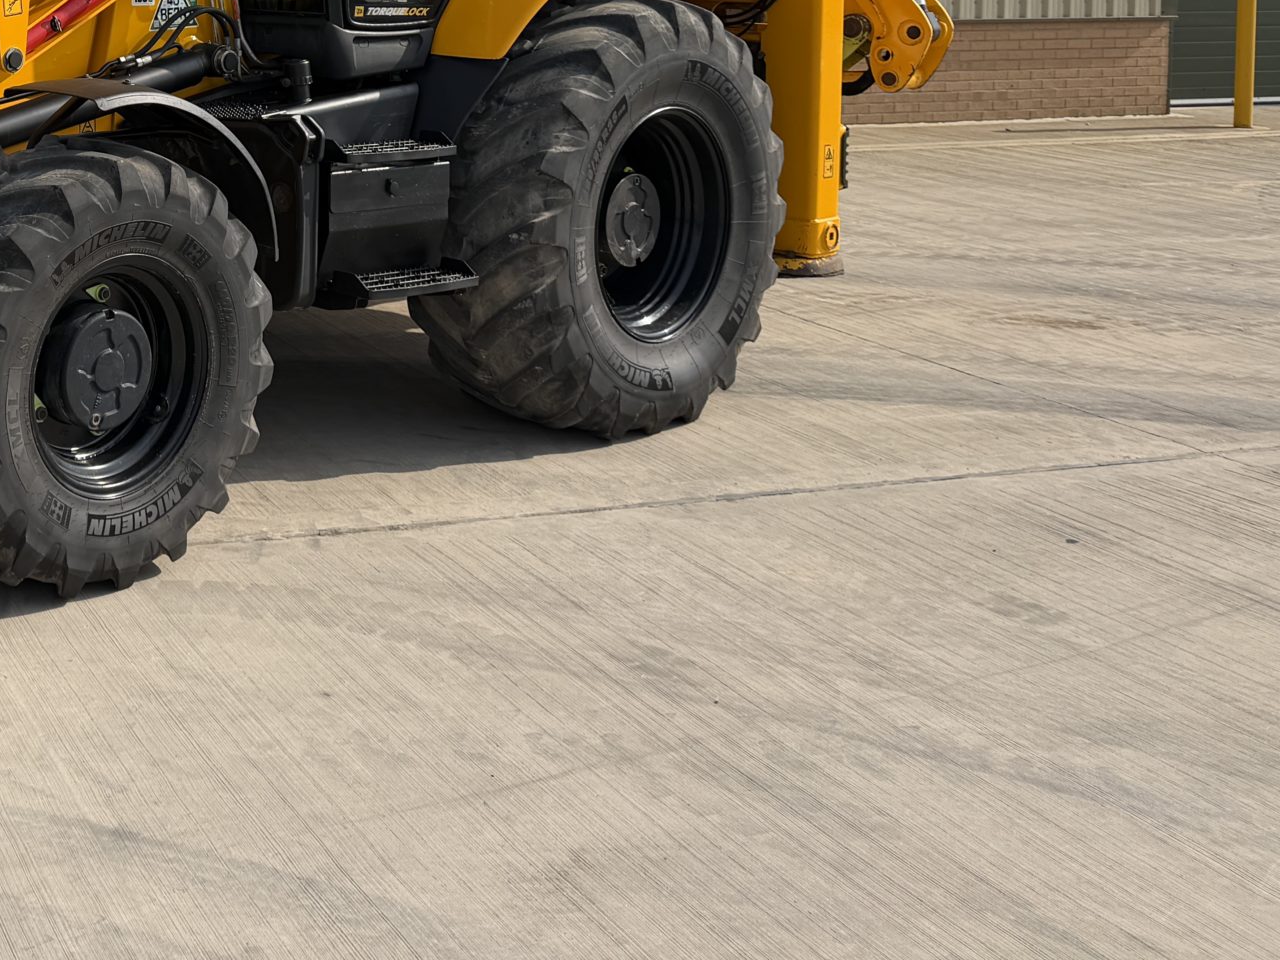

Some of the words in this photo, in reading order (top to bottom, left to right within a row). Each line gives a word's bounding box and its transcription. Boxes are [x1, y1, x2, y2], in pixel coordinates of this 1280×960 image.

[367, 7, 430, 16] TORQUELOCK
[74, 221, 173, 263] MICHELIN
[87, 485, 181, 535] MICHELIN
